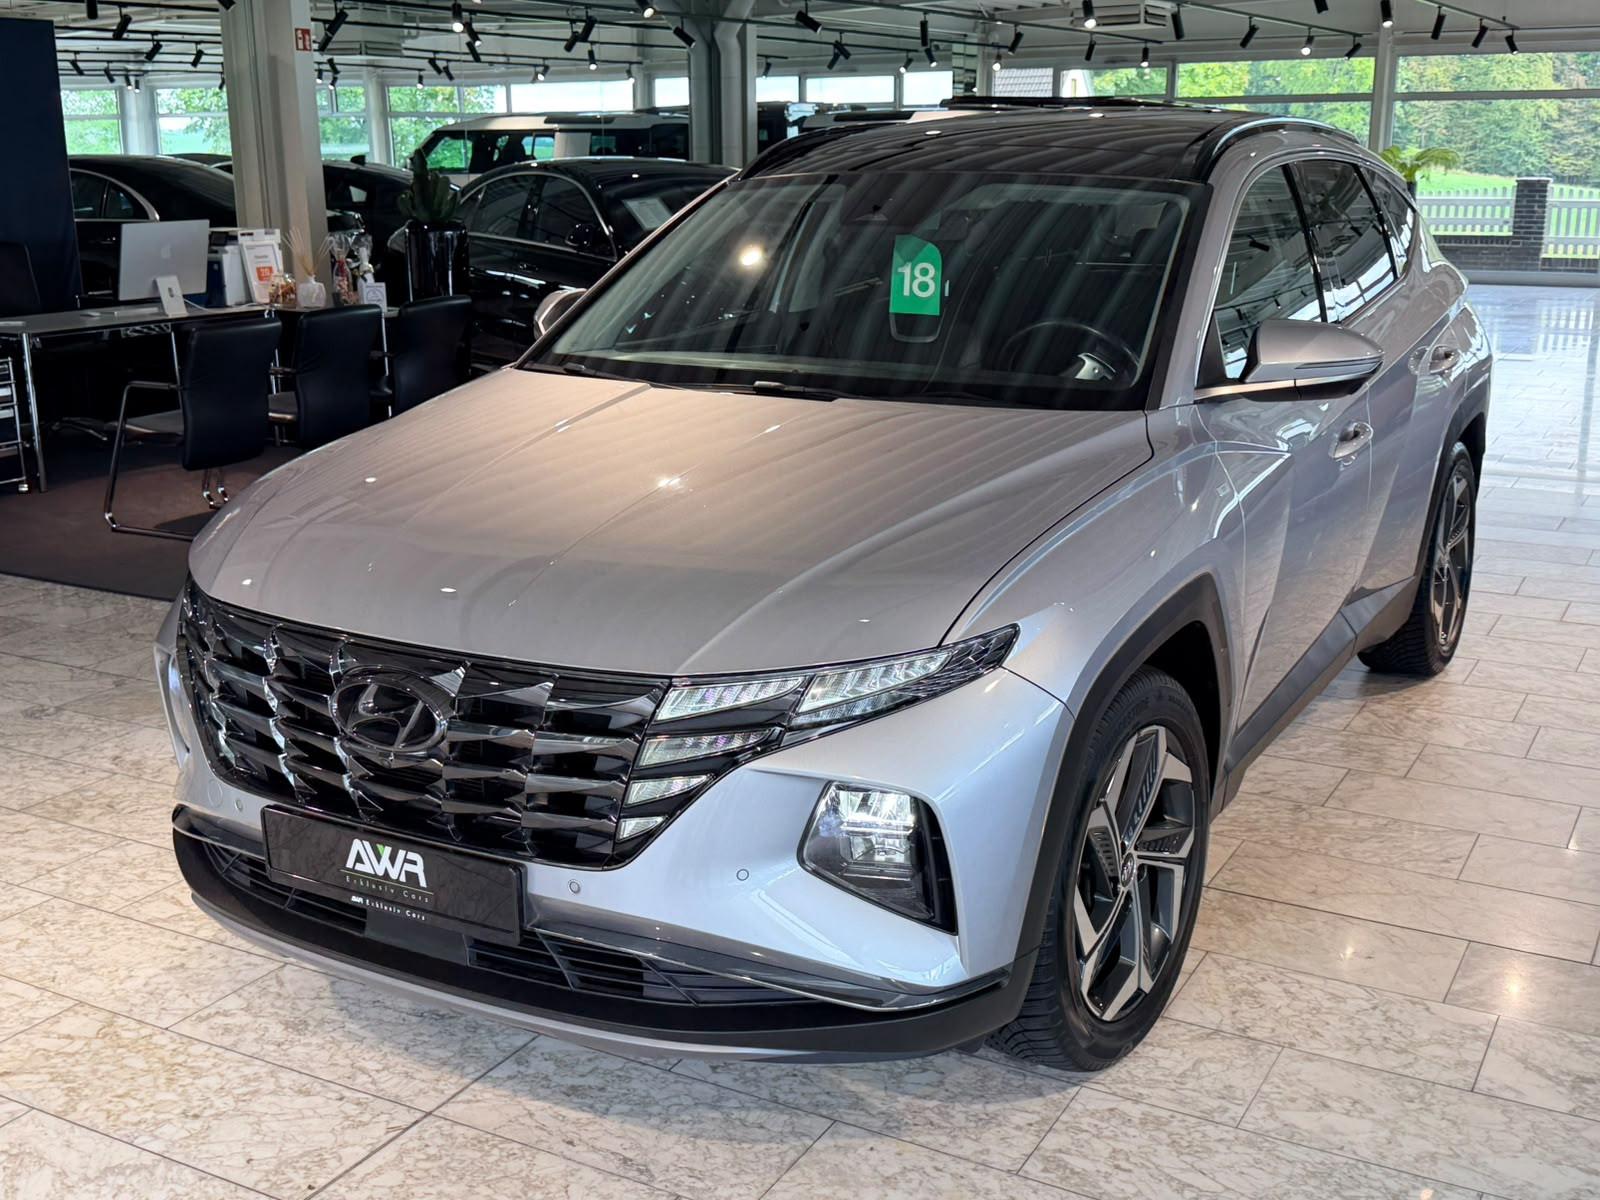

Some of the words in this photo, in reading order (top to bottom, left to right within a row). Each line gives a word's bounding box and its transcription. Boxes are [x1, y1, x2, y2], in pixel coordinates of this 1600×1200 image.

[897, 261, 936, 298] 18
[345, 838, 427, 888] AWR
[403, 890, 429, 903] Cars
